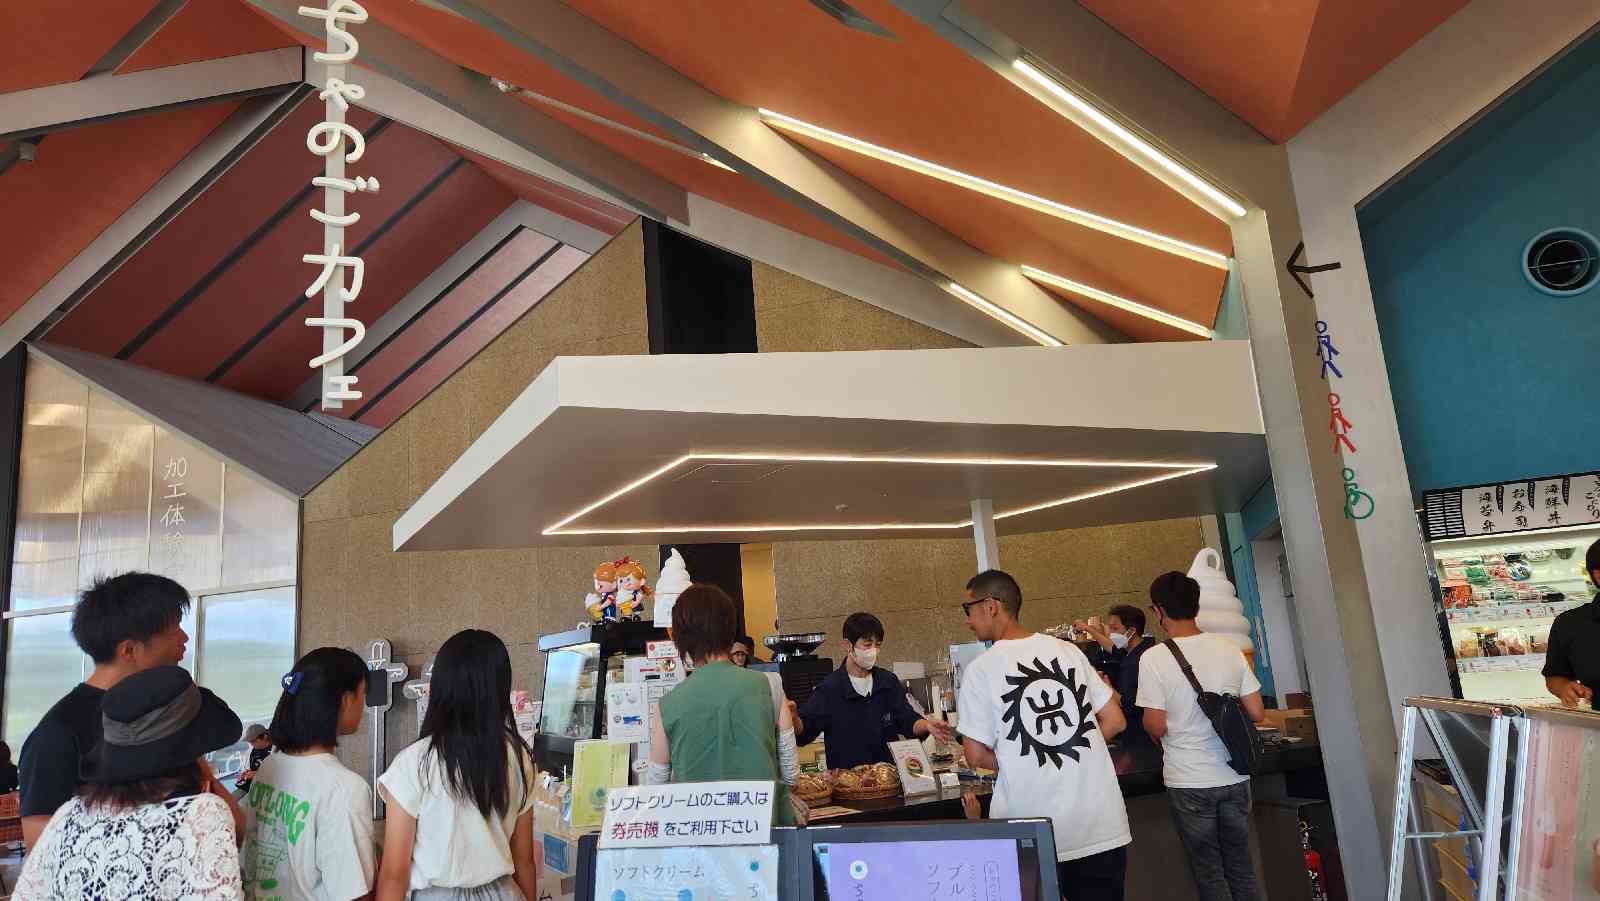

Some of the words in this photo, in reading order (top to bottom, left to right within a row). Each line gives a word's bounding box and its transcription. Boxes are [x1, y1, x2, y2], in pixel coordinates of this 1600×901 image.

[1512, 487, 1529, 529] お寿司
[1544, 484, 1562, 524] 海鮮丼
[610, 790, 769, 812] ソフトクリームのご購入は
[611, 820, 660, 840] 券売機
[664, 818, 760, 836] をご利用下さい
